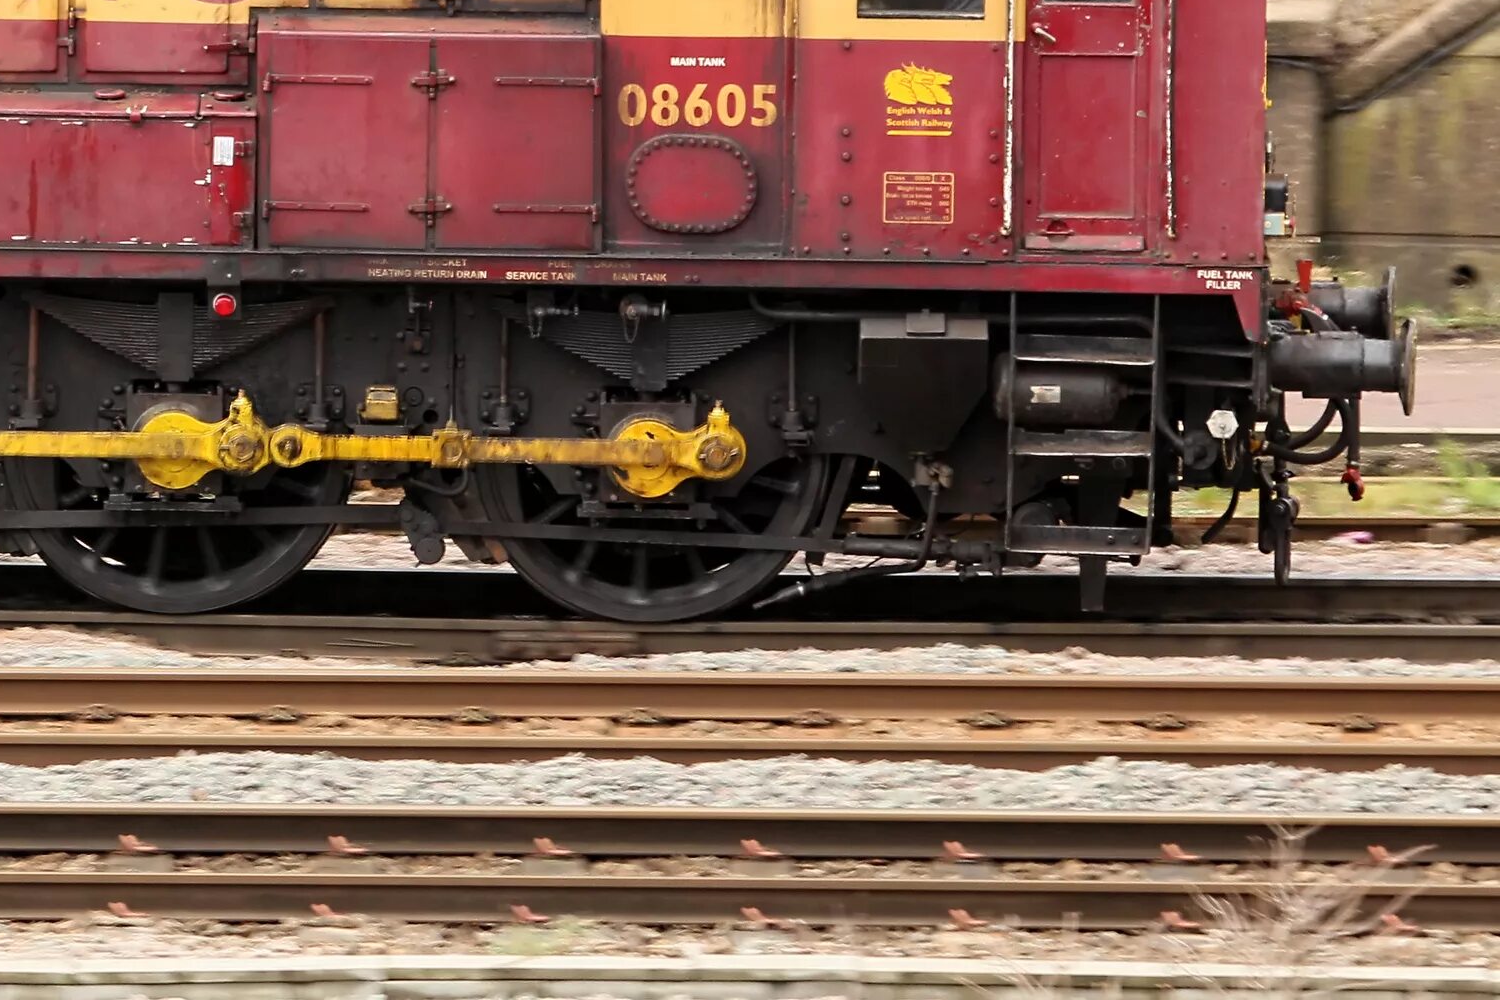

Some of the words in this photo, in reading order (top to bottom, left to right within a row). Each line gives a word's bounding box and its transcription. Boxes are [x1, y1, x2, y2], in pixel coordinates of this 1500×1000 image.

[670, 56, 696, 66] MAIN
[698, 57, 726, 67] TANK
[617, 83, 778, 127] 08605
[887, 106, 916, 116] English
[917, 107, 942, 115] Welsh
[944, 107, 952, 115] &
[886, 118, 920, 126] Scottish
[921, 119, 952, 128] Railway
[368, 268, 411, 278] HEATING
[414, 269, 454, 278] RETURN
[456, 270, 487, 279] DRAIN
[505, 271, 548, 280] SERVICE
[640, 273, 667, 281] TANK
[1197, 270, 1223, 279] FUEL
[1225, 270, 1253, 280] TANK
[1206, 280, 1241, 290] FILLER
